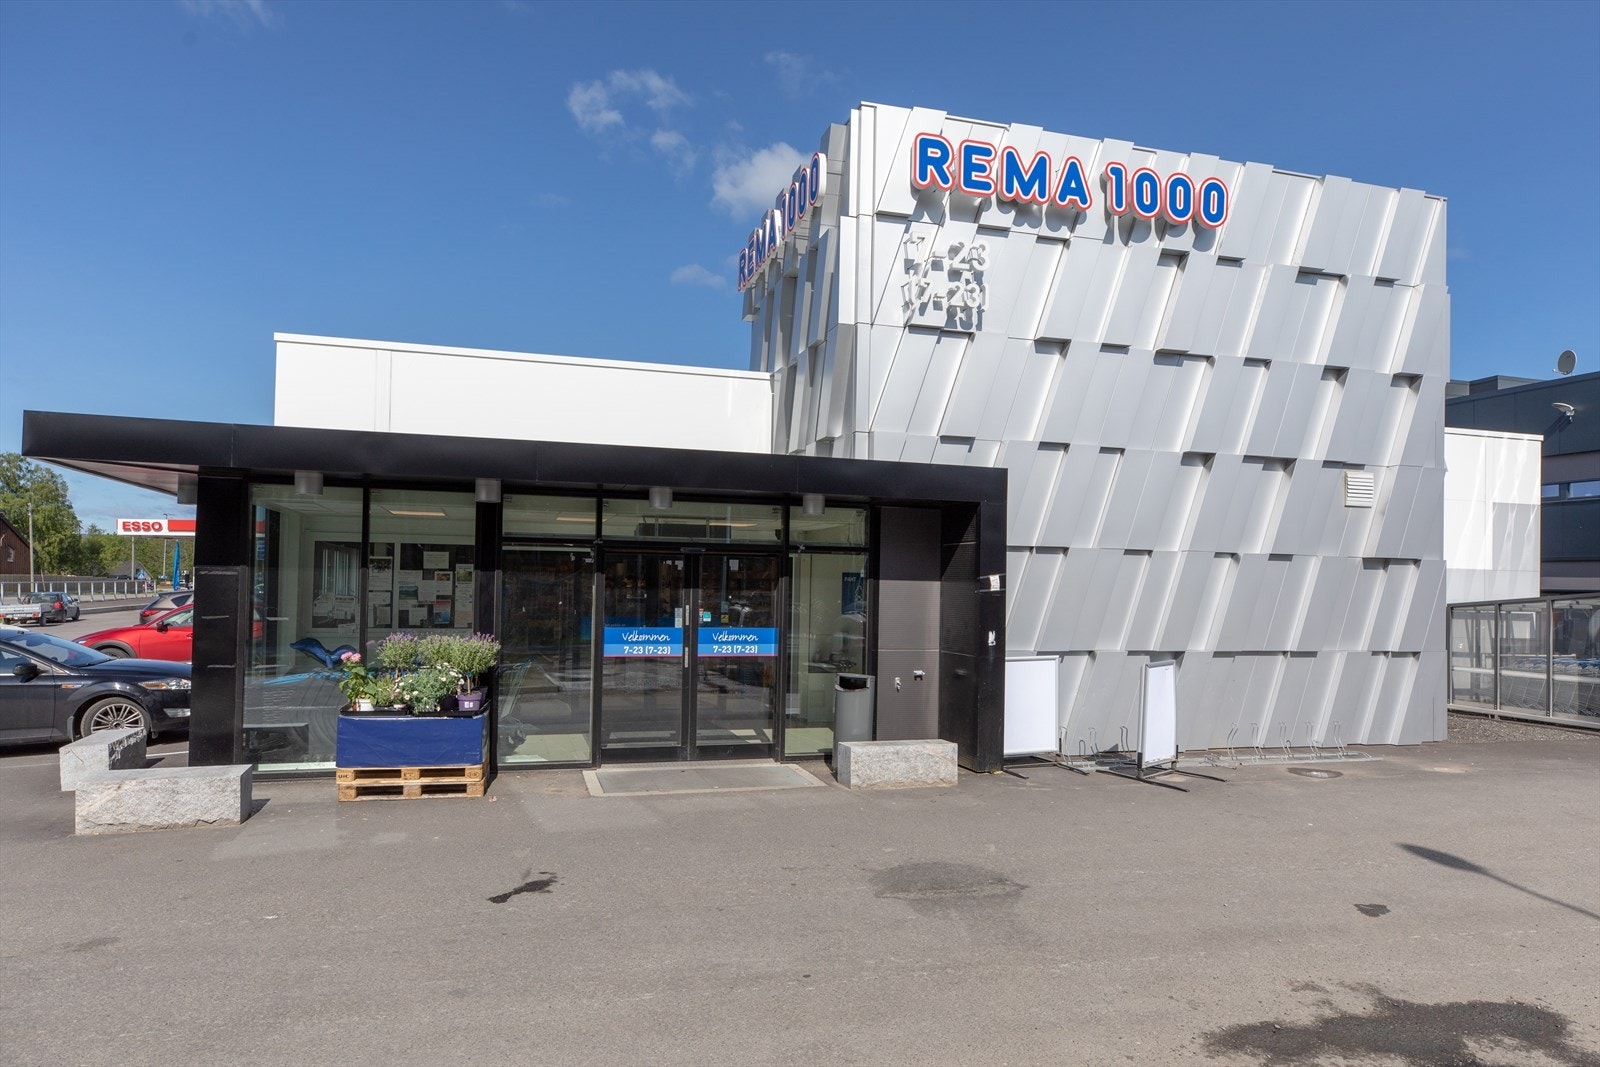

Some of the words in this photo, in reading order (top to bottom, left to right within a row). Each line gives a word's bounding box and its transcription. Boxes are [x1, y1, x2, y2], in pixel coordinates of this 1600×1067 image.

[914, 132, 1092, 211] REMA
[1106, 161, 1228, 229] 1000
[738, 209, 777, 291] REMA
[780, 152, 820, 241] 1000
[122, 521, 163, 532] ESSO
[622, 630, 671, 642] Velkommen
[712, 630, 759, 642] Velkommen
[623, 646, 644, 655] 7-23
[645, 646, 671, 655] (7-23)
[713, 645, 732, 654] 7-23
[733, 645, 758, 654] (7-23)
